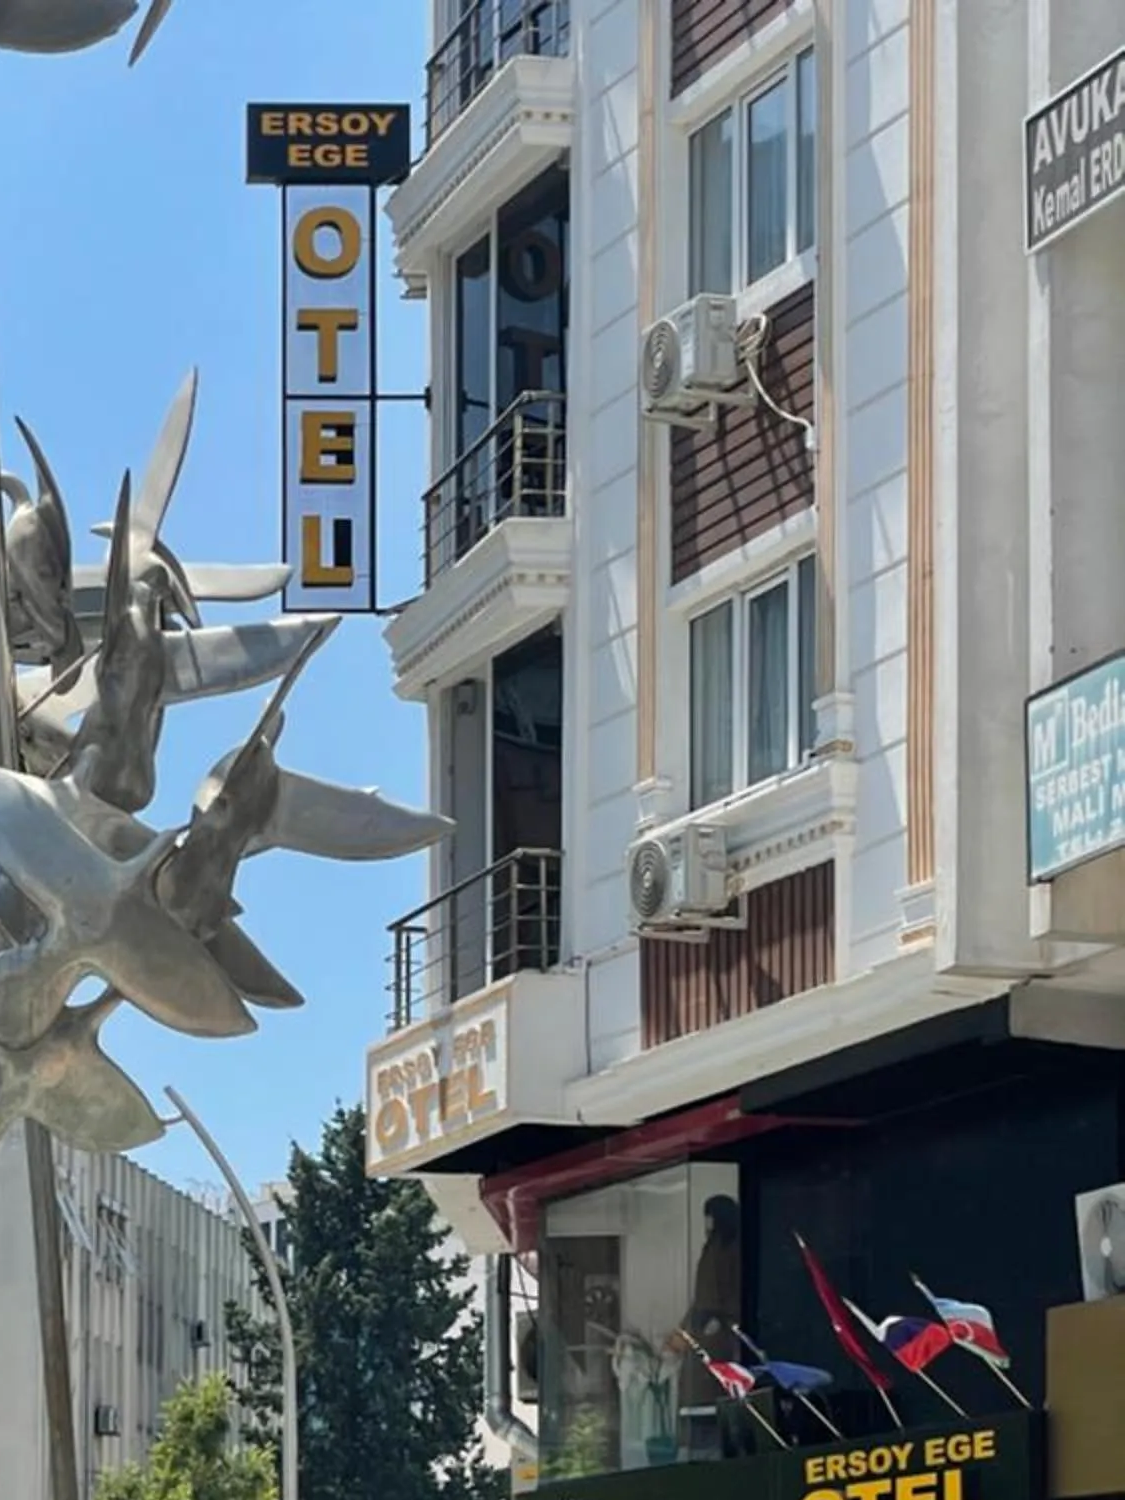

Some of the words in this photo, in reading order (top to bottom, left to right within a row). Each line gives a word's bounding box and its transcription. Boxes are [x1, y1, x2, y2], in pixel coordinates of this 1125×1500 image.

[261, 111, 397, 136] ERSOY
[288, 143, 369, 167] EGE
[293, 206, 362, 588] OTEL
[376, 1064, 497, 1154] OTEL
[806, 1442, 914, 1484] ERSOY
[925, 1430, 996, 1465] EGE
